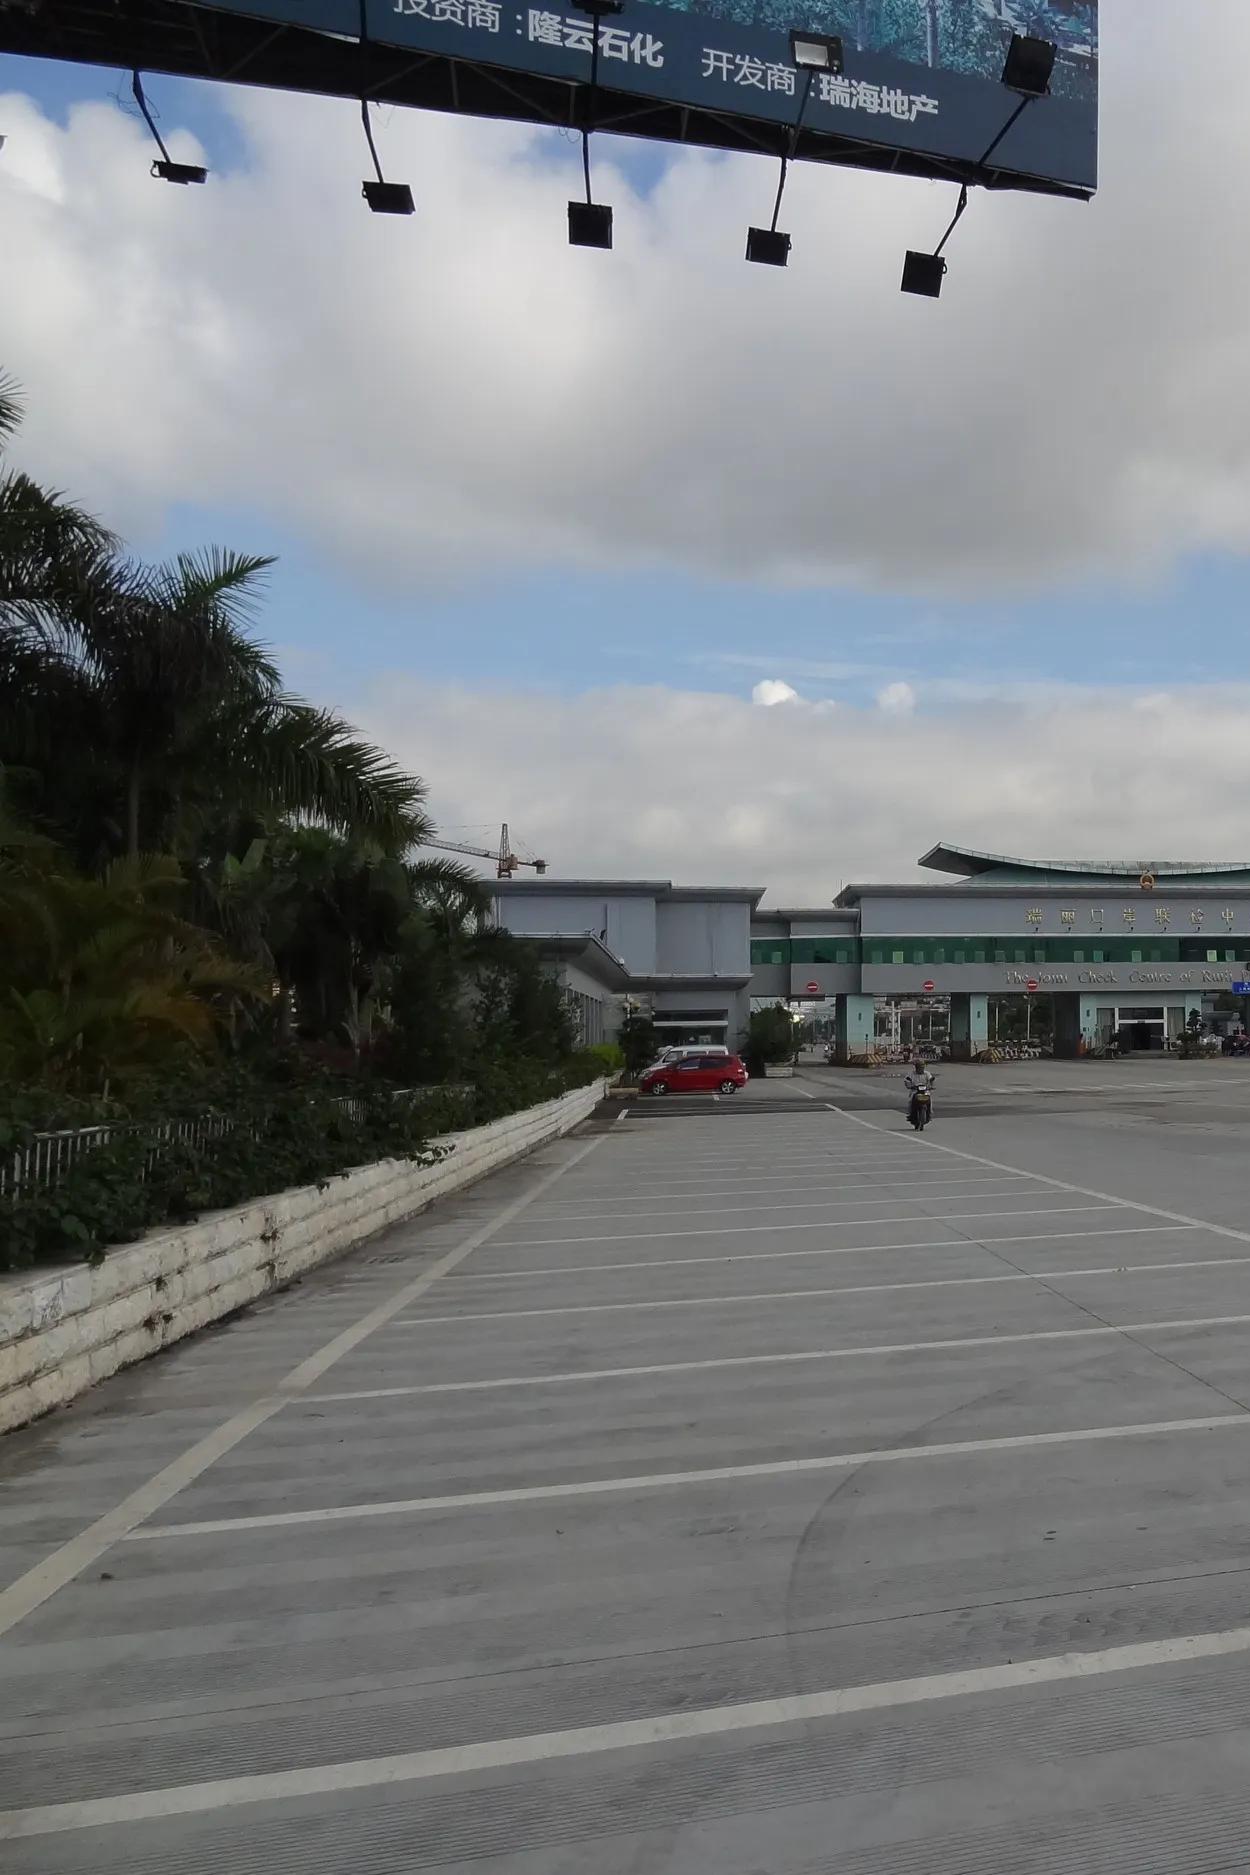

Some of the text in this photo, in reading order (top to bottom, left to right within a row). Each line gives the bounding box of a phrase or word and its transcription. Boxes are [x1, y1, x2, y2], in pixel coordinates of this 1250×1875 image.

[1004, 970, 1028, 985] The
[1078, 970, 1118, 985] Check
[1128, 970, 1172, 985] Centre
[1179, 970, 1195, 985] of
[1201, 970, 1233, 985] Ruili
